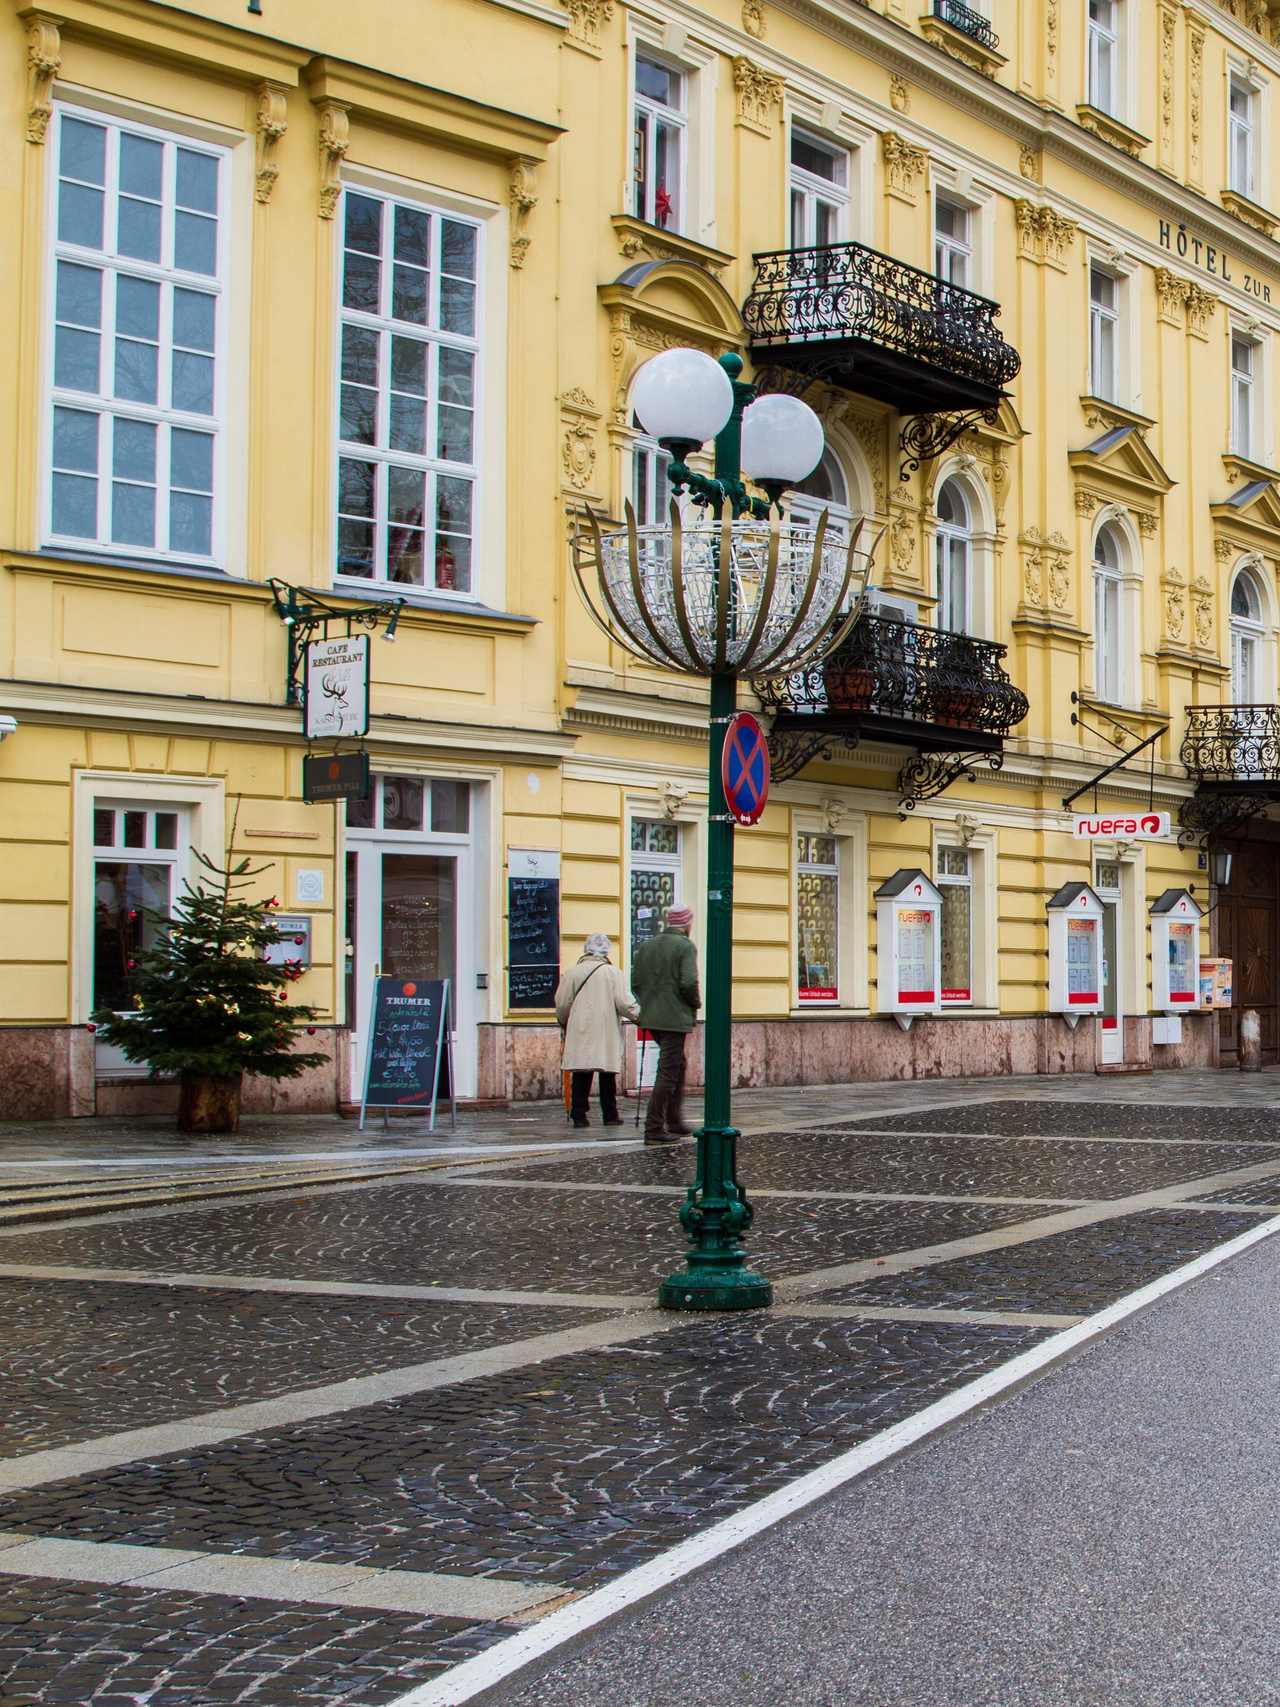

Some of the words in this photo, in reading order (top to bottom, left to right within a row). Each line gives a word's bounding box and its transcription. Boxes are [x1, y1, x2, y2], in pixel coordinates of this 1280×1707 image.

[1244, 274, 1271, 303] ZUR
[327, 644, 348, 655] CAFE
[312, 653, 363, 668] RESTAURANT
[312, 784, 342, 793] TRUMER
[345, 781, 360, 791] PILS
[1079, 819, 1137, 835] ruefa
[899, 912, 922, 923] ruefa
[1068, 921, 1088, 931] ruefa
[386, 997, 431, 1006] TRUMER
